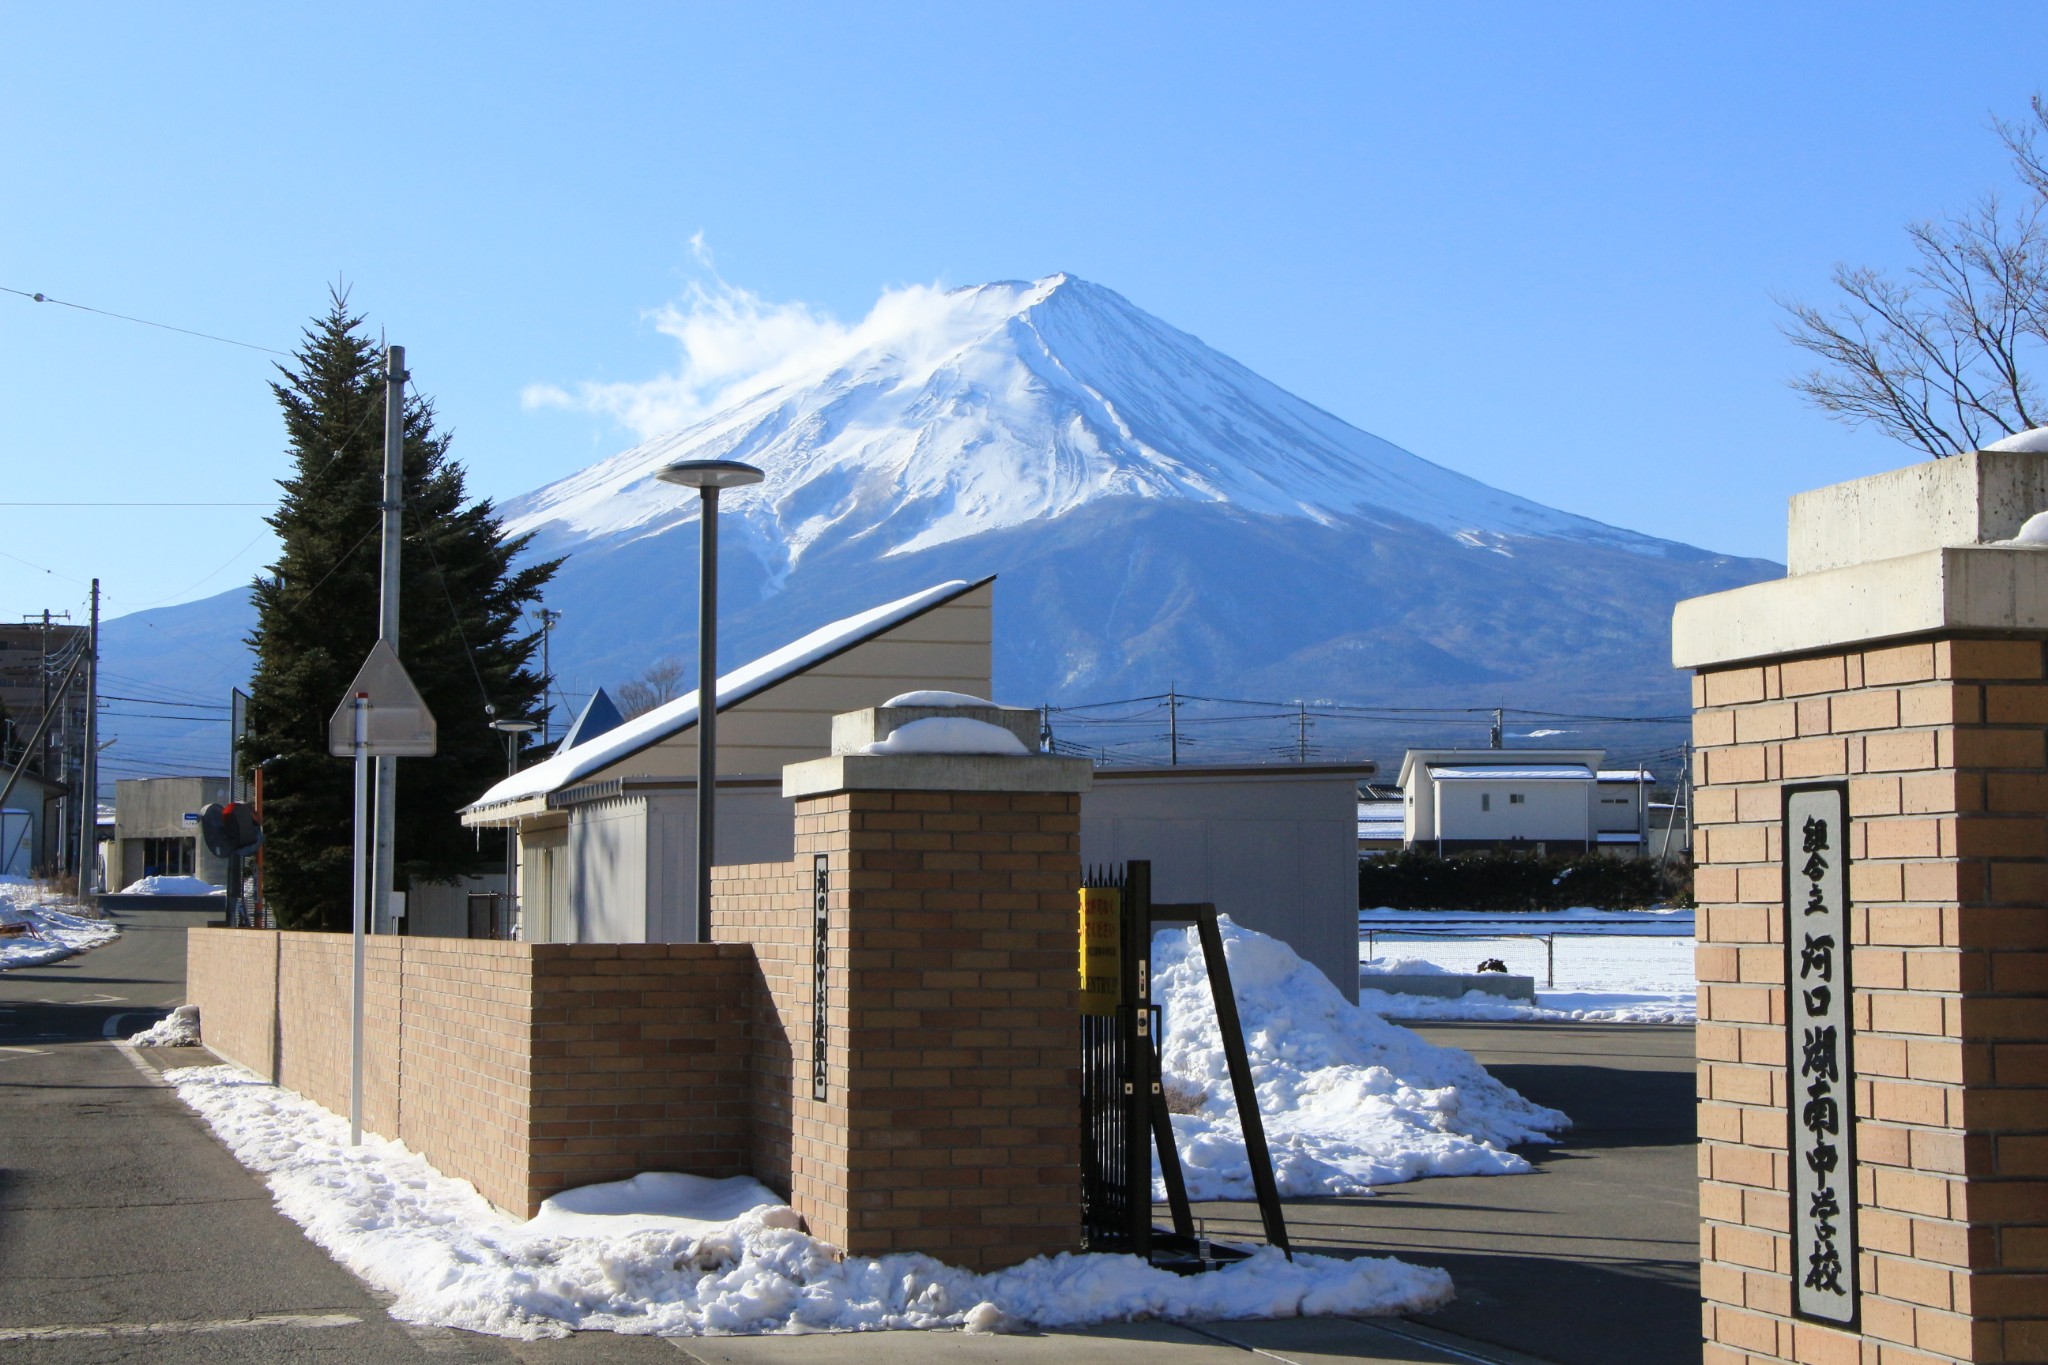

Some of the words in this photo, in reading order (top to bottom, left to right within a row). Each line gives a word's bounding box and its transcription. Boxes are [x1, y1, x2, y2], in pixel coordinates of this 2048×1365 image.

[1801, 815, 1830, 916] 組合立
[1801, 932, 1846, 1296] 河口湖南中学校
